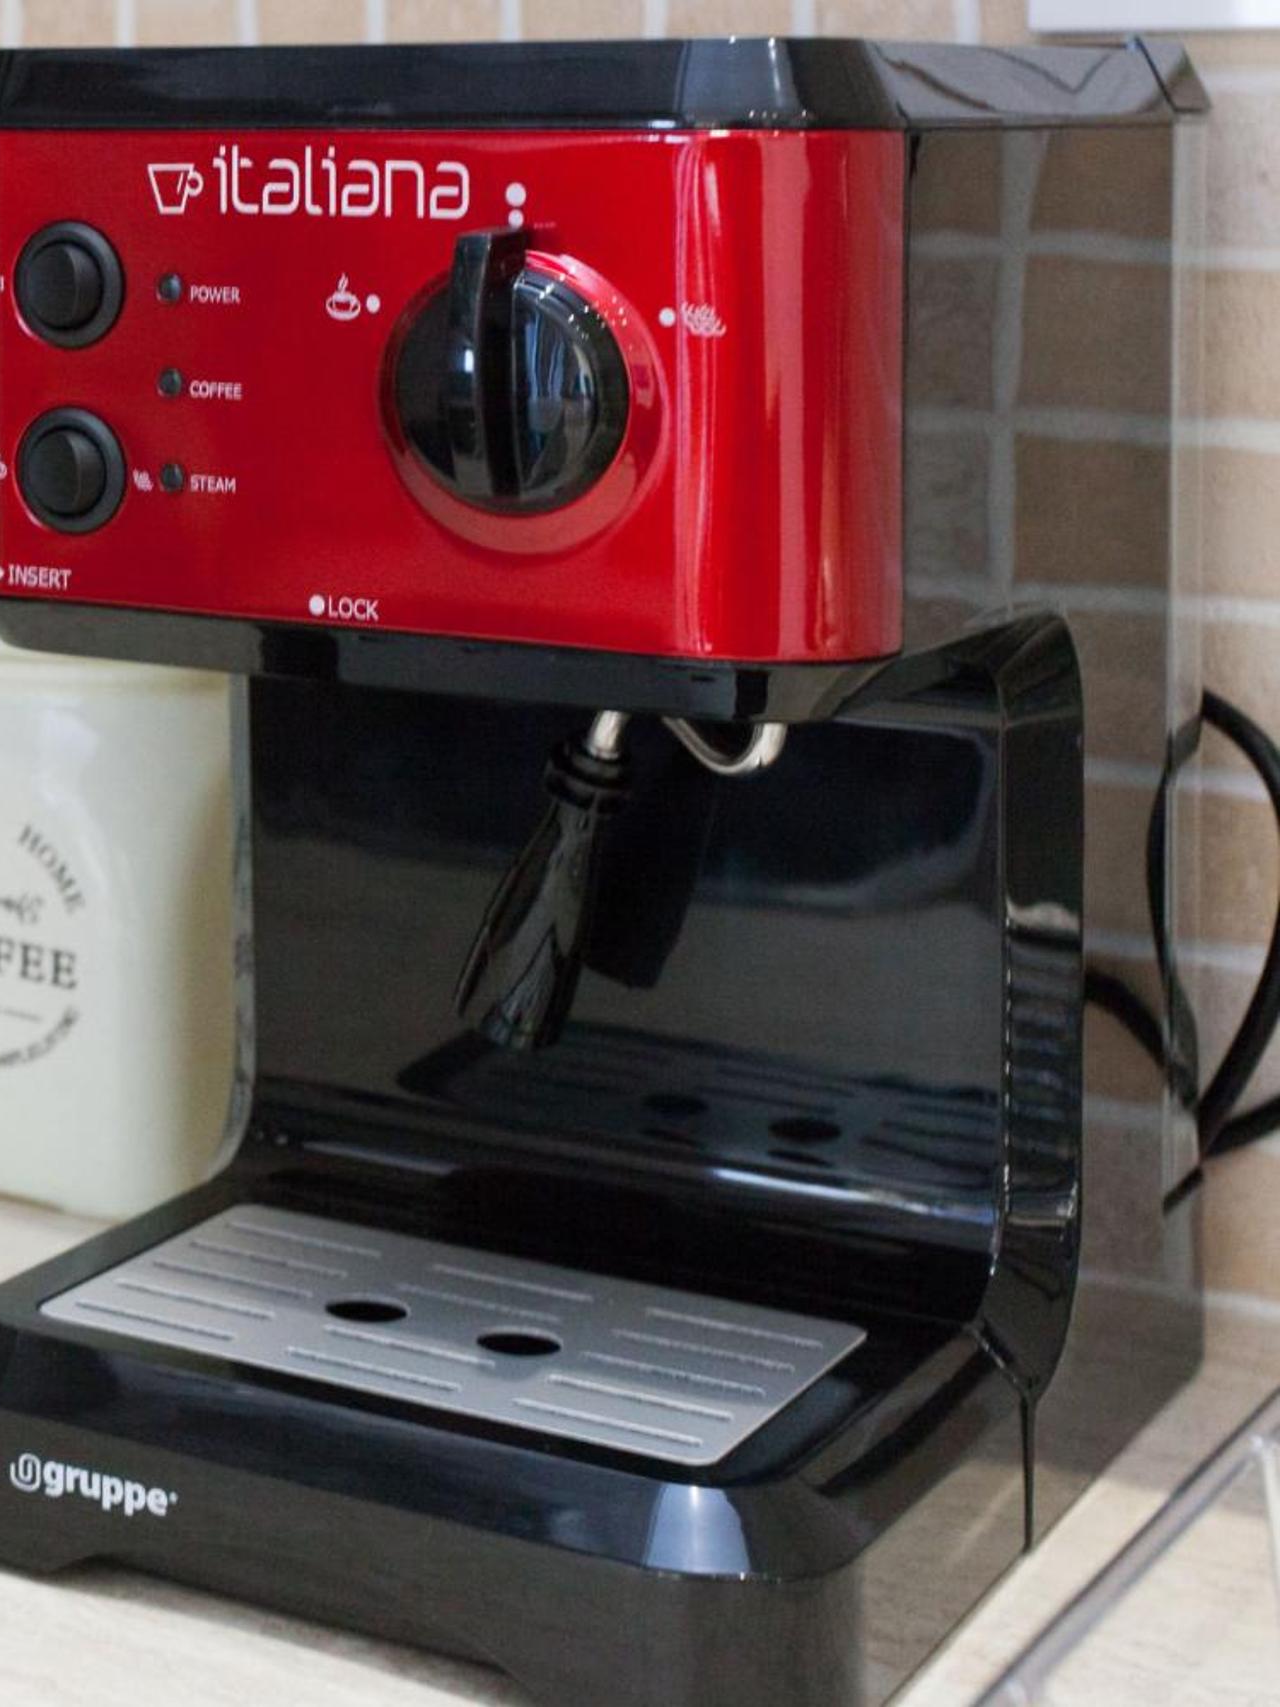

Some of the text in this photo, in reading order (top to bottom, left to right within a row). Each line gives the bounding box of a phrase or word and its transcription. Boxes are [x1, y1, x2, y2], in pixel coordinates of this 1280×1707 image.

[213, 144, 471, 220] italiana
[189, 285, 240, 304] POWER
[189, 380, 242, 400] COFFEE
[190, 474, 236, 493] STEAM
[7, 564, 72, 590] INSERT
[328, 598, 379, 621] LOCK
[18, 825, 86, 914] HOME
[42, 1460, 168, 1517] gruppe
